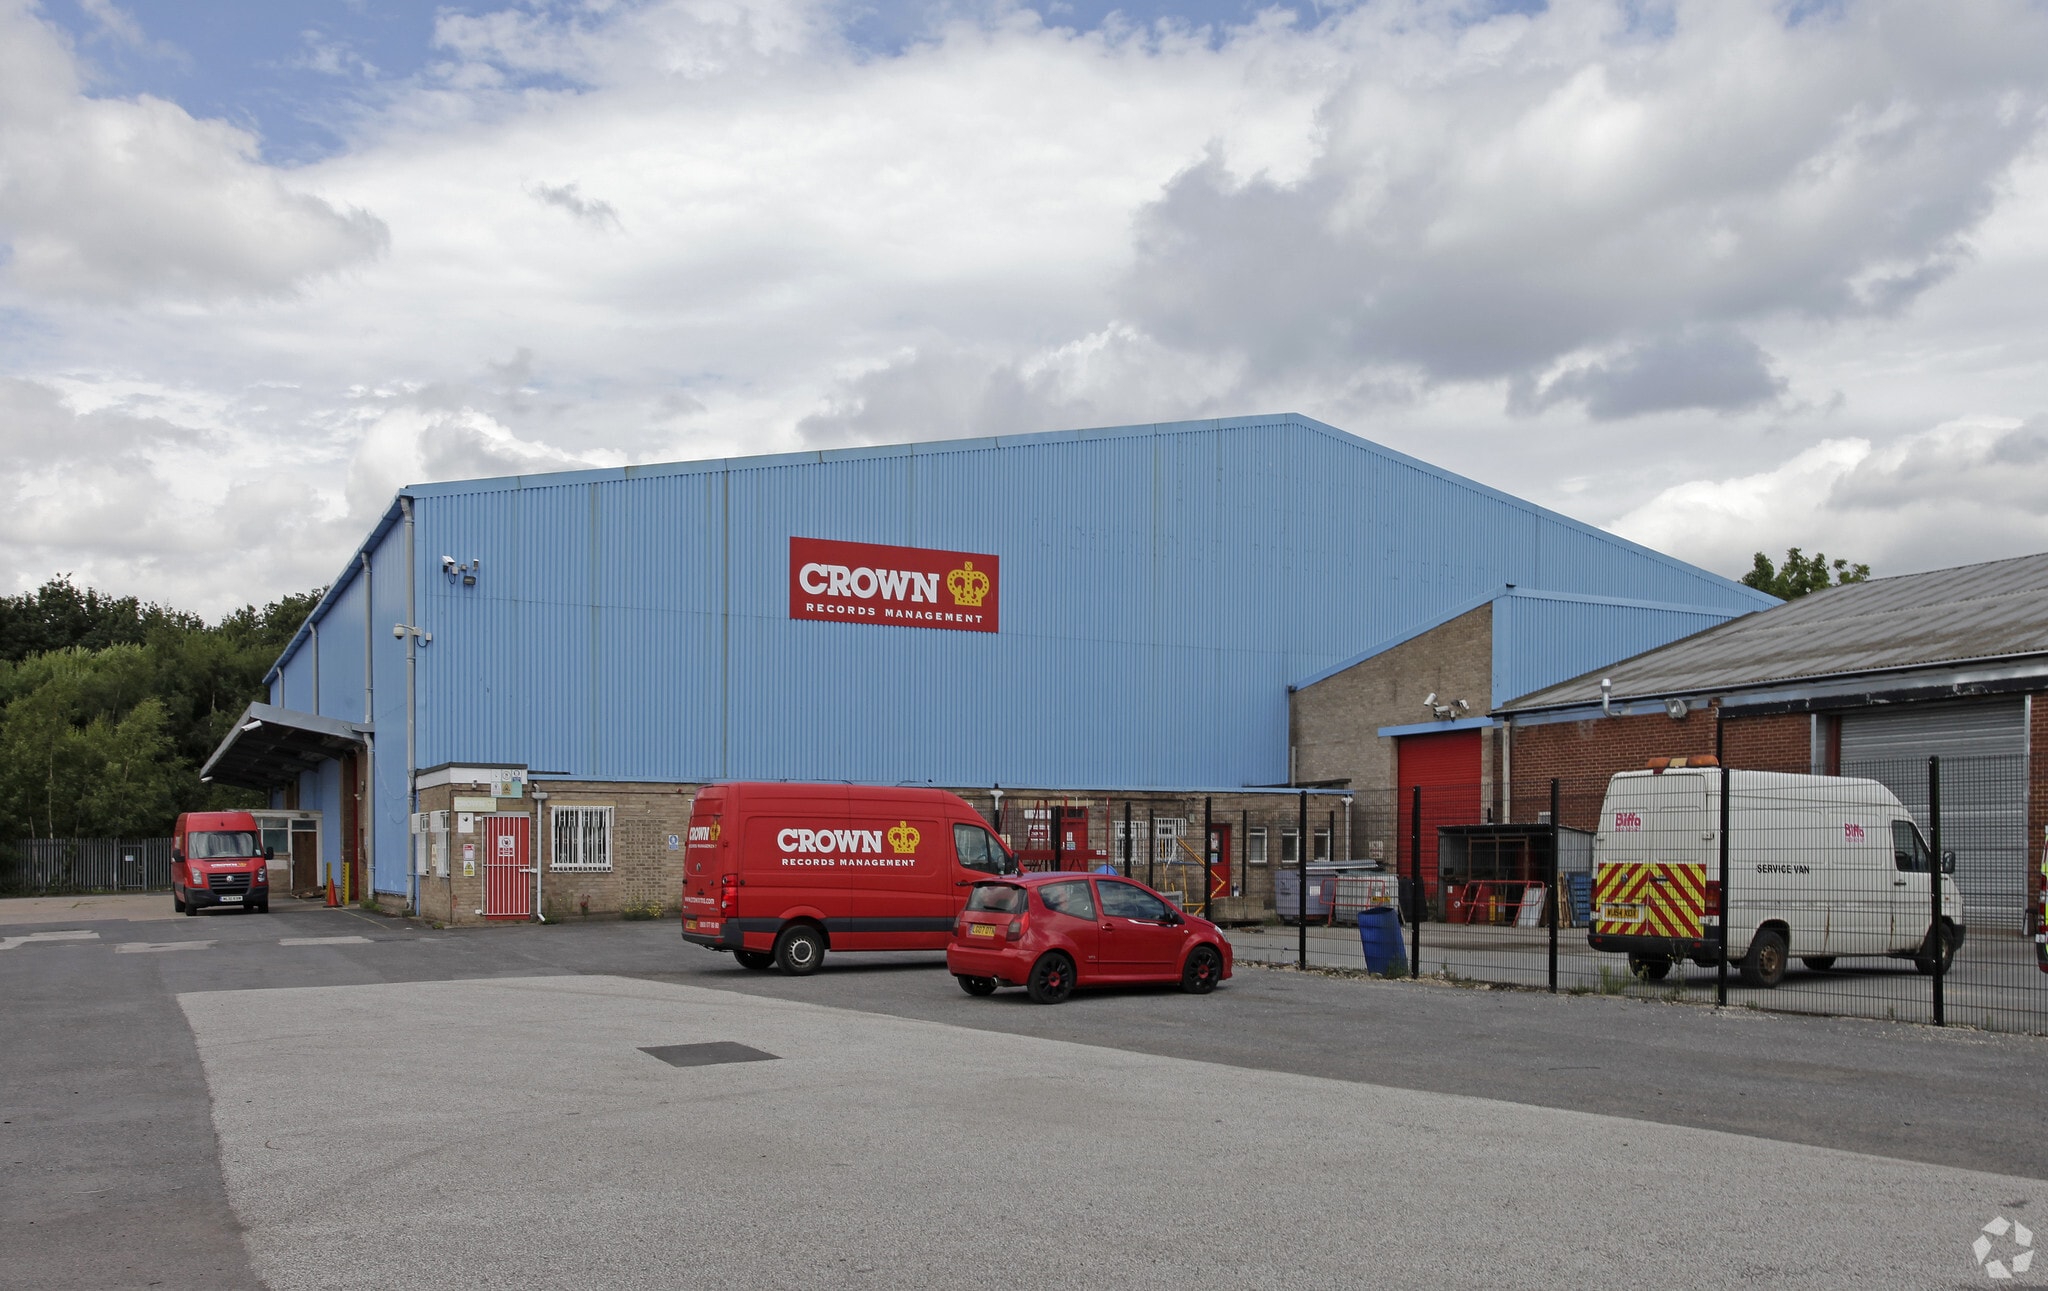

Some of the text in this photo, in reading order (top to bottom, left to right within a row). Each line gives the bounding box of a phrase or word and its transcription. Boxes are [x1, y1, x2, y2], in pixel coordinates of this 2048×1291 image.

[799, 562, 940, 604] CROWN
[806, 602, 983, 624] RECORDS MANAGEMENT
[1615, 812, 1641, 827] Biffa
[689, 826, 710, 841] CROWN
[1845, 822, 1864, 838] Biffa
[777, 828, 882, 853] CROWN
[782, 858, 915, 867] RECORDS MANAGEMENT
[1756, 863, 1810, 875] SERVICE VAN
